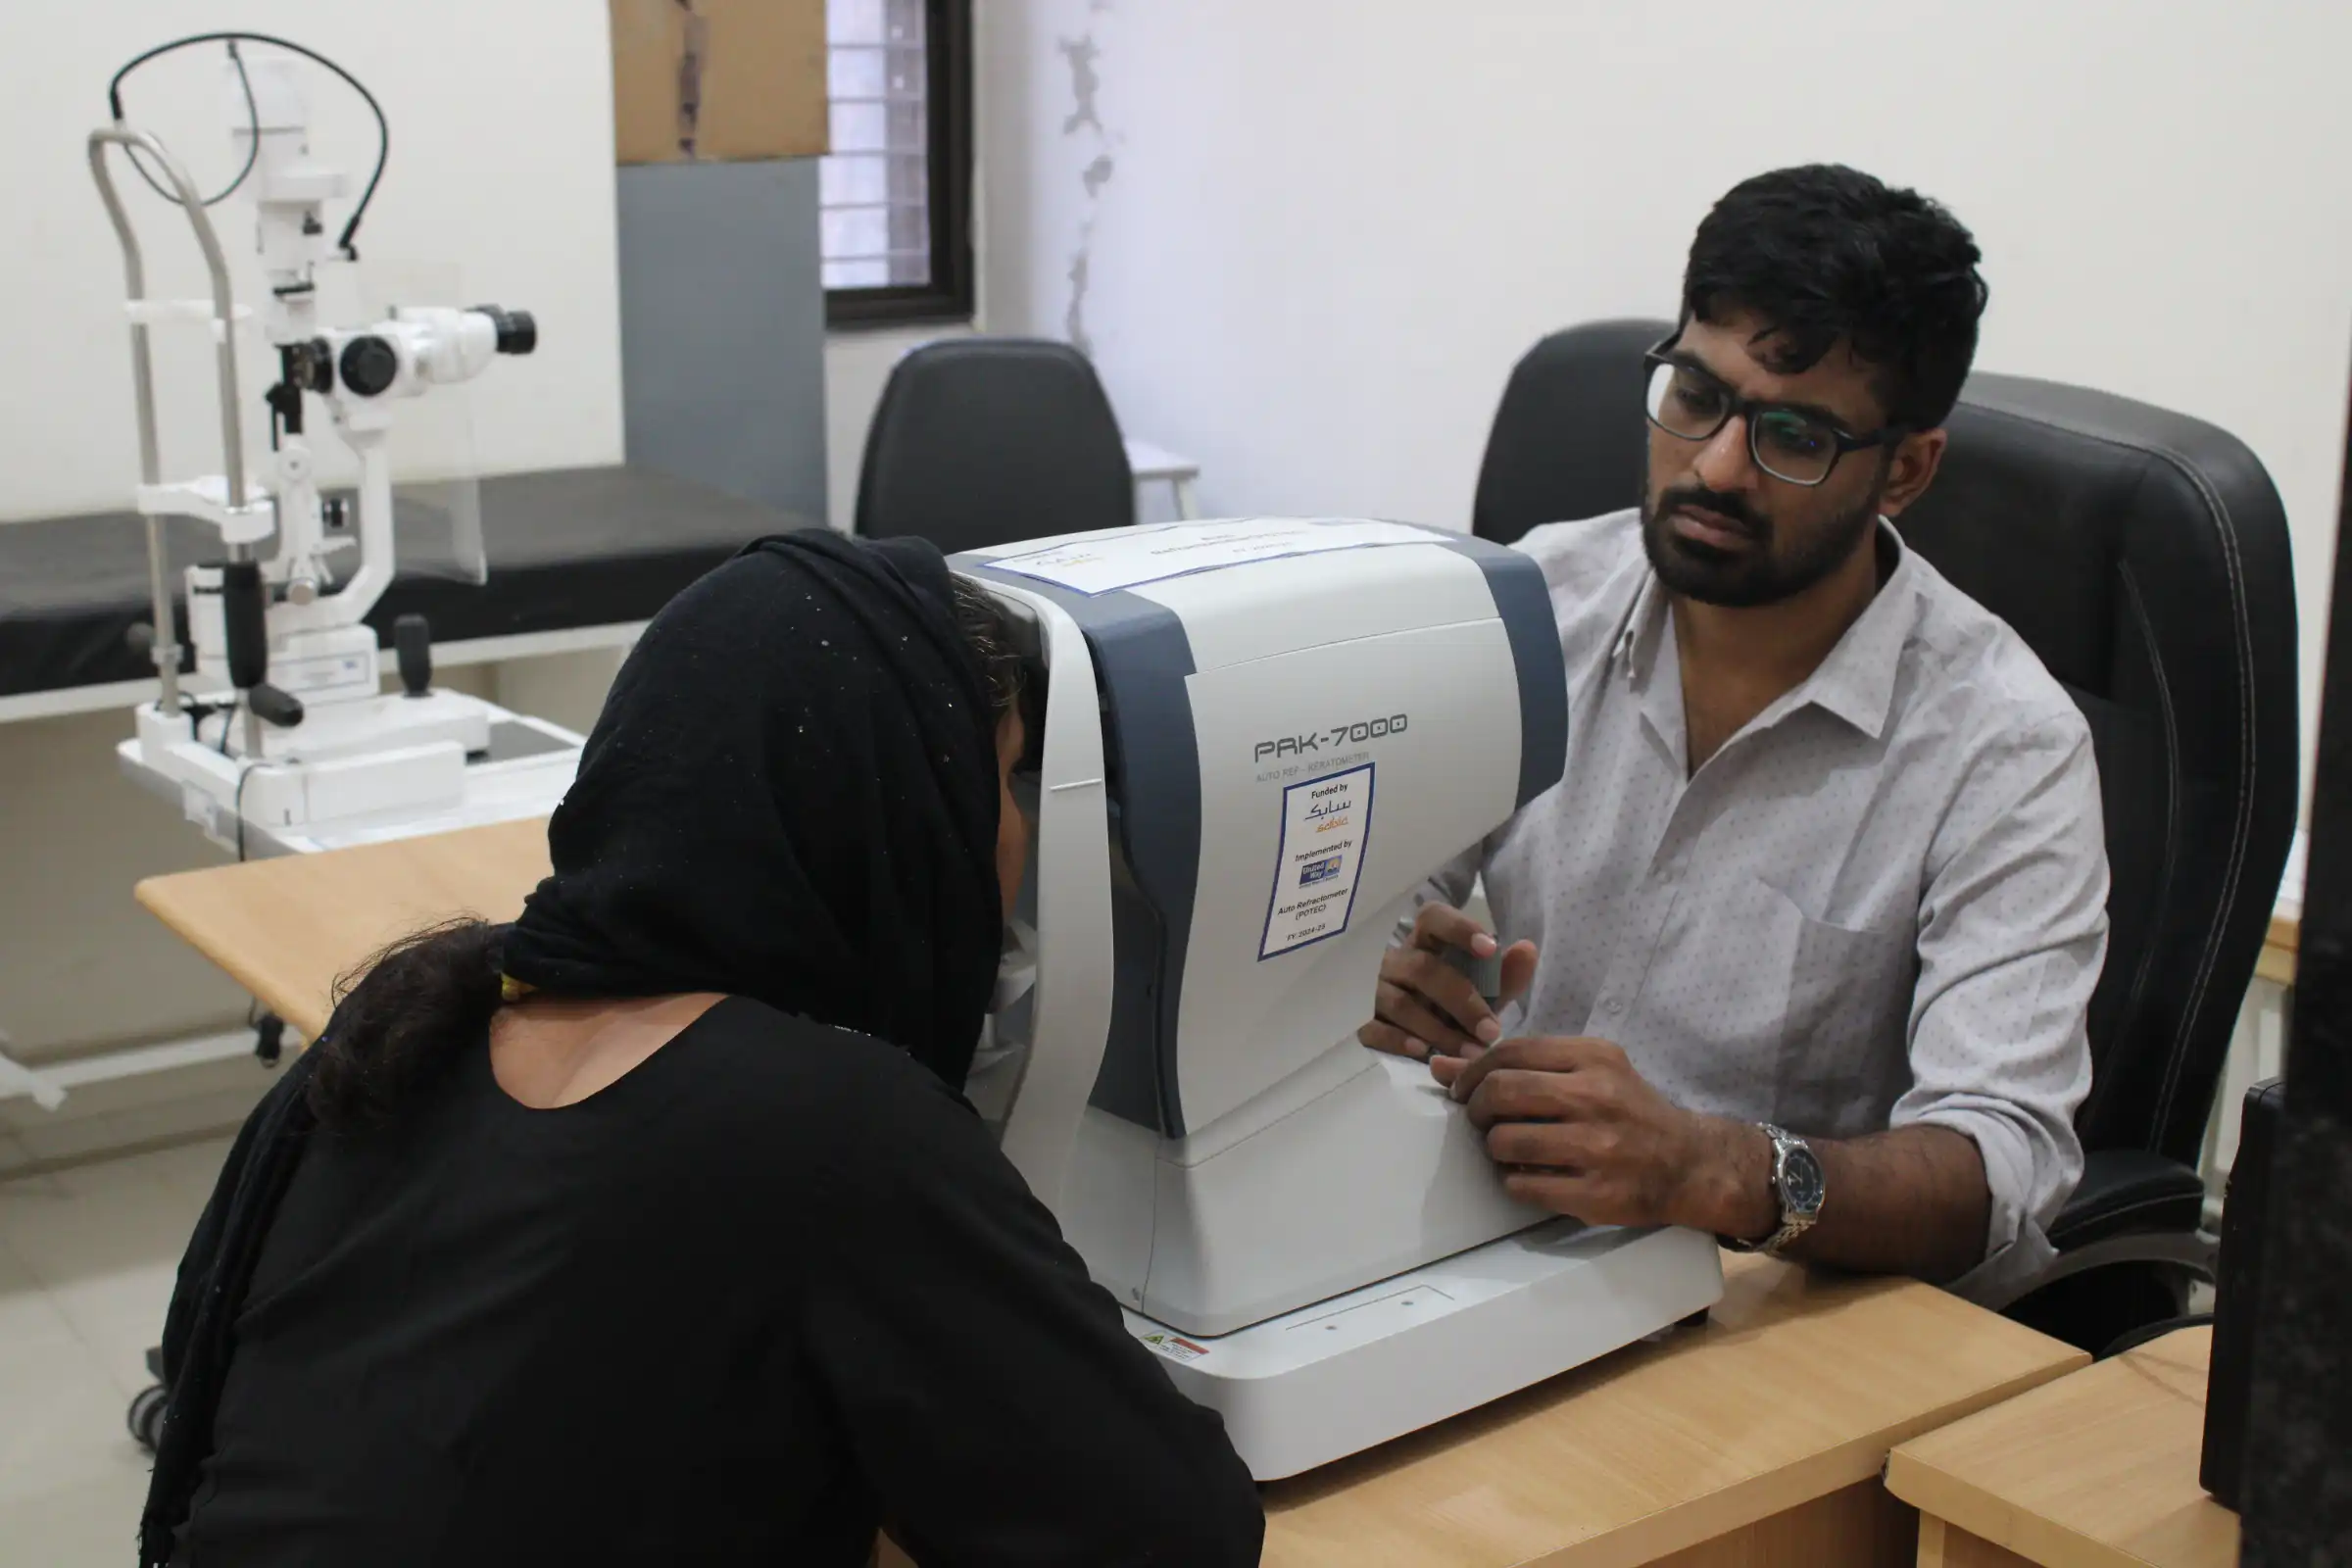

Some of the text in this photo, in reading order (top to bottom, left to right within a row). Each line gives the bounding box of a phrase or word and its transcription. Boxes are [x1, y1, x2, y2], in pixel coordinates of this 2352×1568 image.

[1254, 713, 1407, 762] PAK-7000
[1256, 769, 1280, 782] AUTO
[1283, 765, 1299, 778] REF
[1308, 752, 1370, 773] KERATOMETER
[1311, 783, 1348, 799] Funded by
[1295, 840, 1352, 862] Implemented by
[1302, 861, 1325, 874] United
[1310, 870, 1323, 879] Way
[1277, 887, 1348, 915] Auto Refractometer
[1296, 903, 1327, 920] (POTEC)
